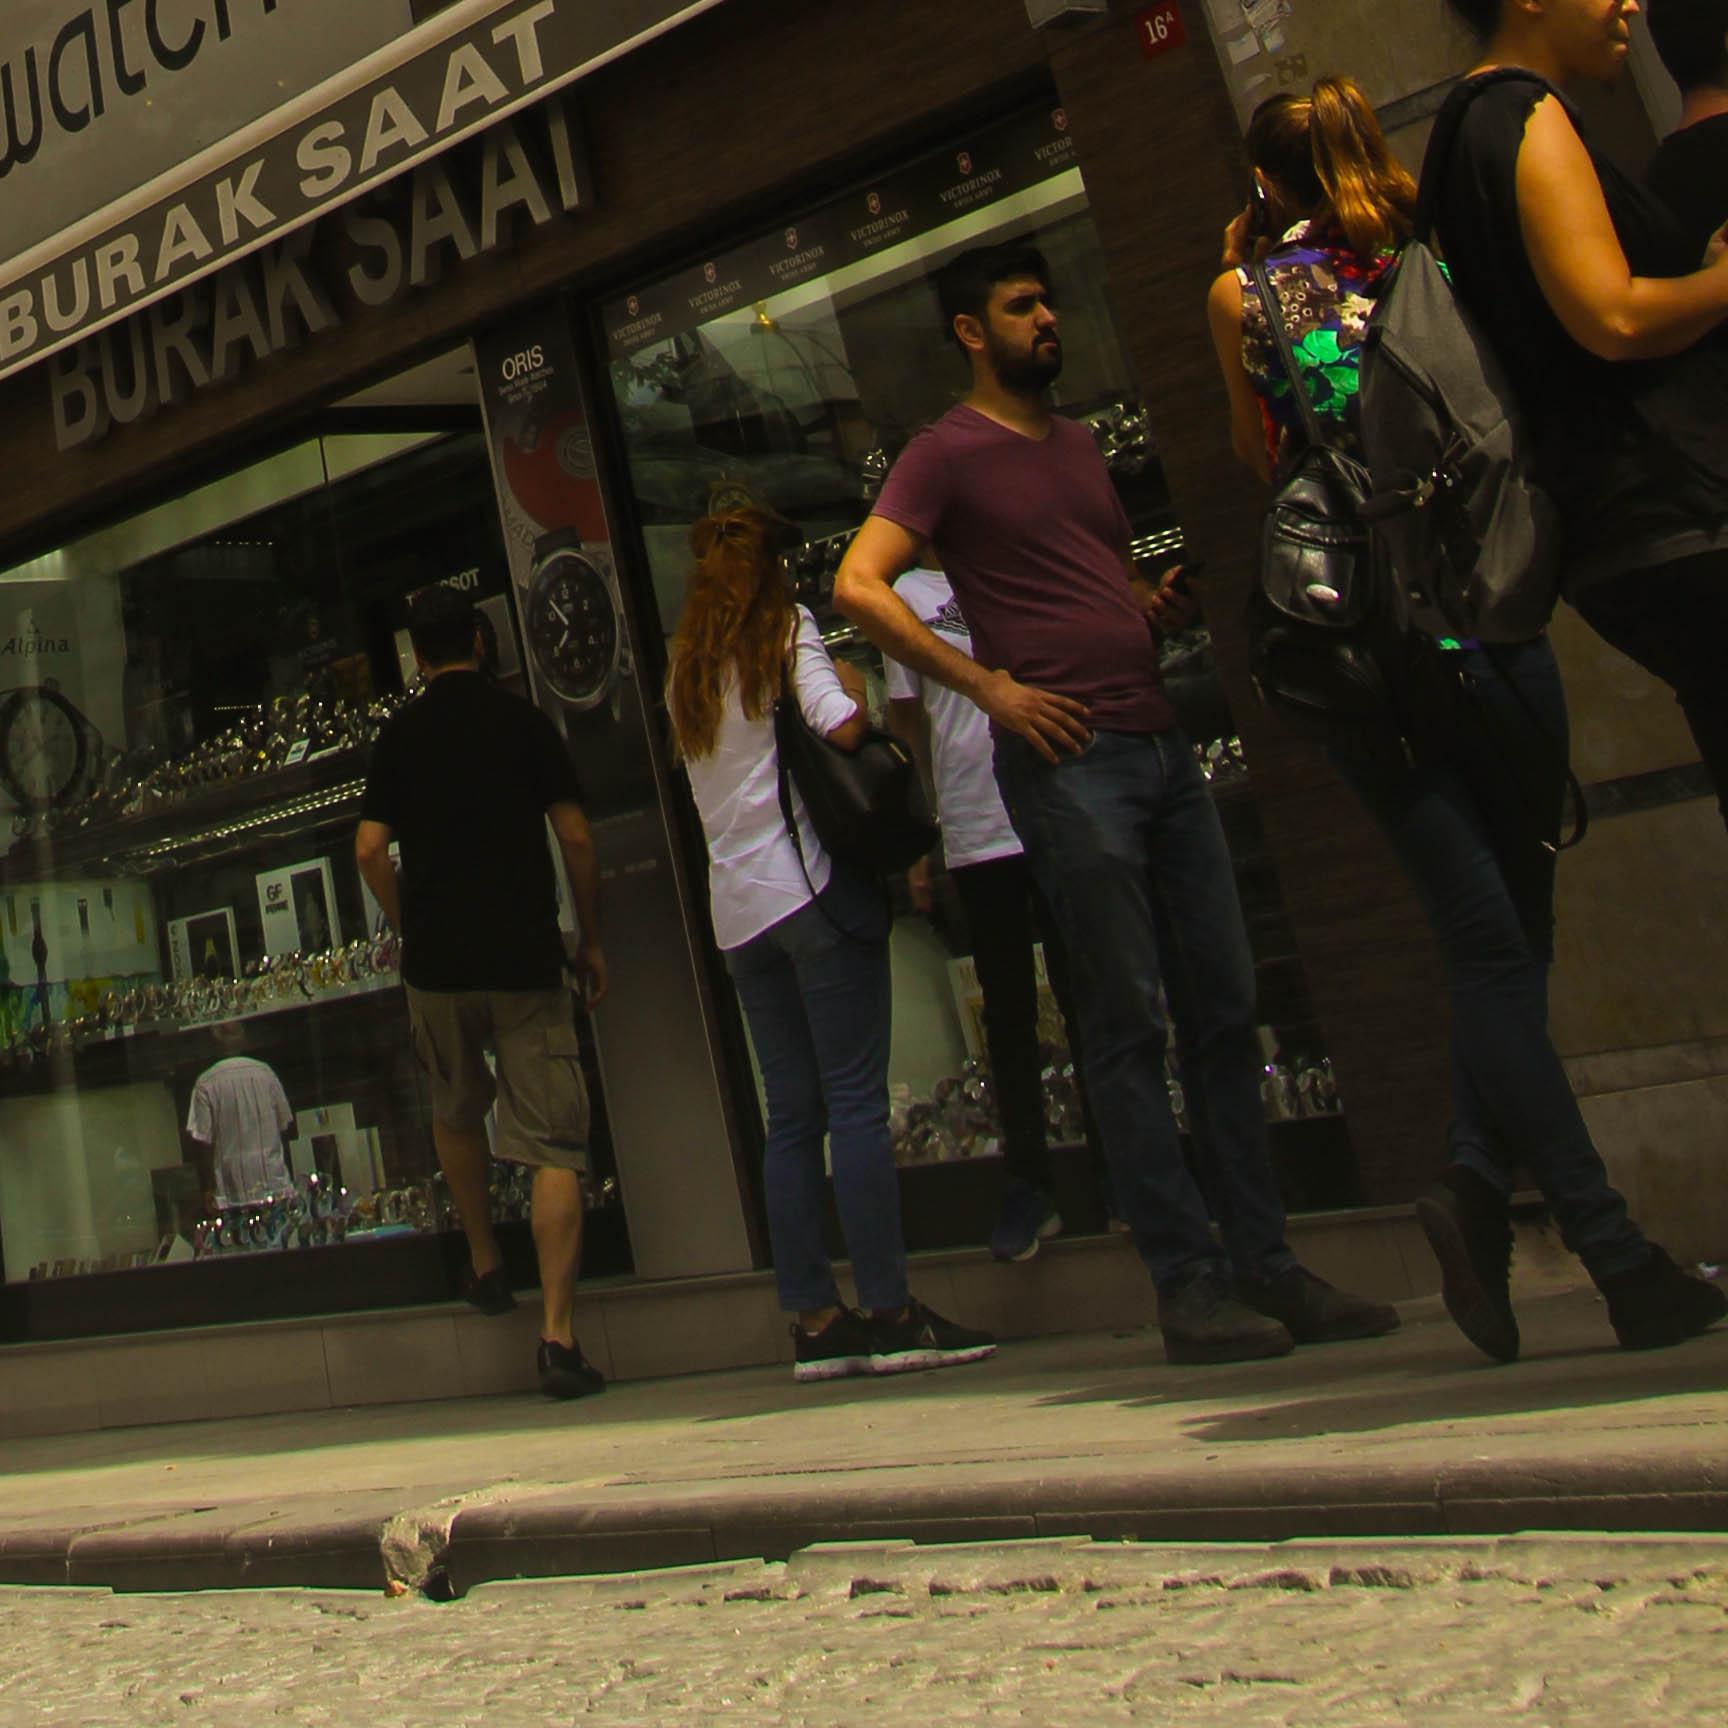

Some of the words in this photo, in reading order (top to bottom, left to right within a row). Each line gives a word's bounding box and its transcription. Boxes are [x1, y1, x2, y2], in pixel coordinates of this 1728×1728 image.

[49, 222, 343, 450] BURAK
[501, 345, 545, 381] ORIS
[404, 567, 480, 608] TSOT
[0, 637, 72, 658] Alpina
